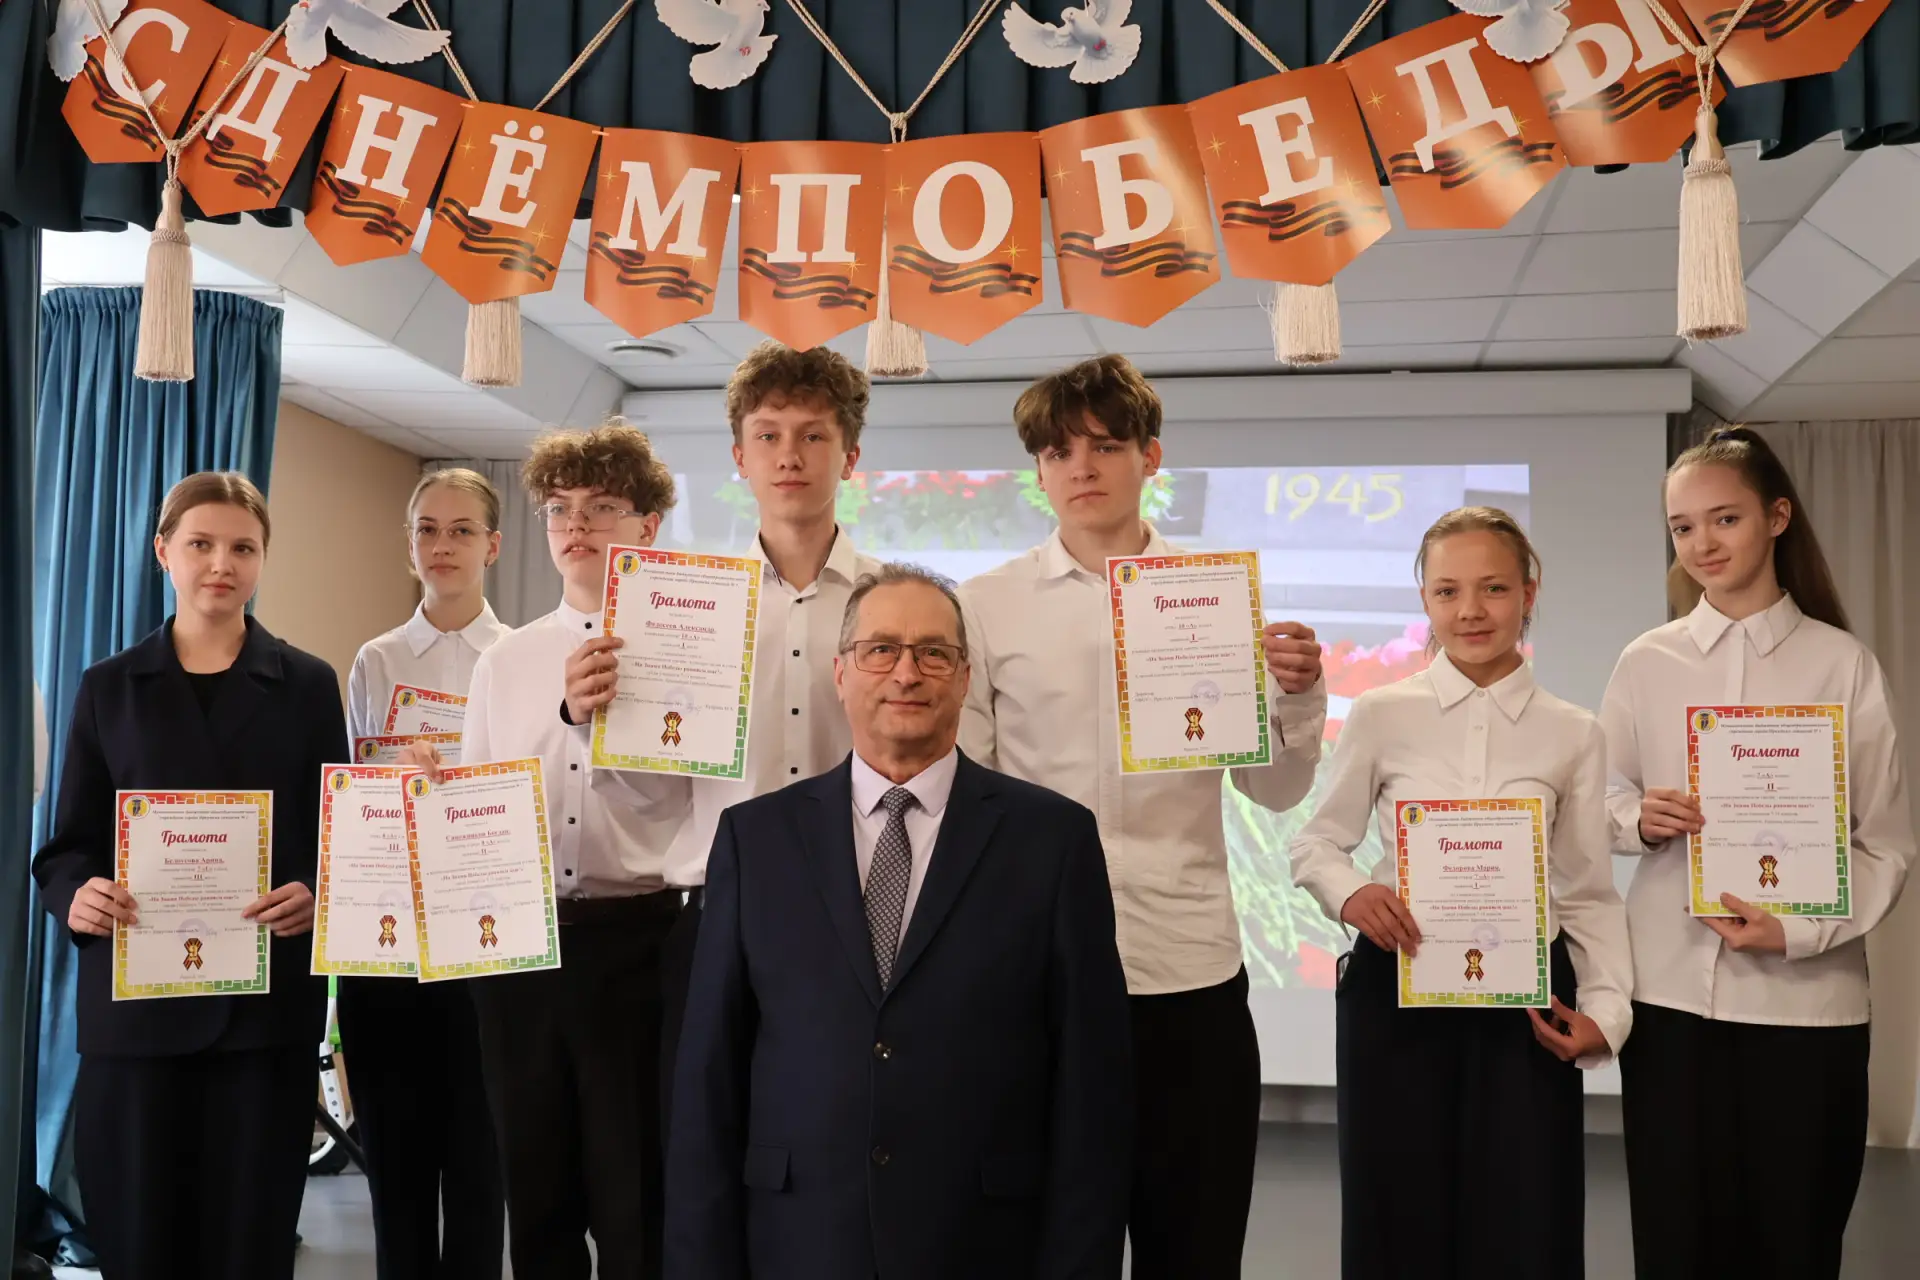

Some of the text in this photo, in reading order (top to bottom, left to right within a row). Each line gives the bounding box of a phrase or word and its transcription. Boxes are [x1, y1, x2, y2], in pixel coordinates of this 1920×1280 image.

[103, 0, 1684, 264] С ДНЁМ ПОБЕДЫ
[1264, 472, 1404, 523] 1945
[650, 591, 717, 611] Грамота
[1154, 595, 1219, 613] Грамота
[1731, 744, 1800, 761] Грамота
[361, 804, 403, 821] Грамо
[444, 804, 506, 823] Грамота
[161, 830, 228, 847] Грамота
[1438, 837, 1503, 854] Грамота
